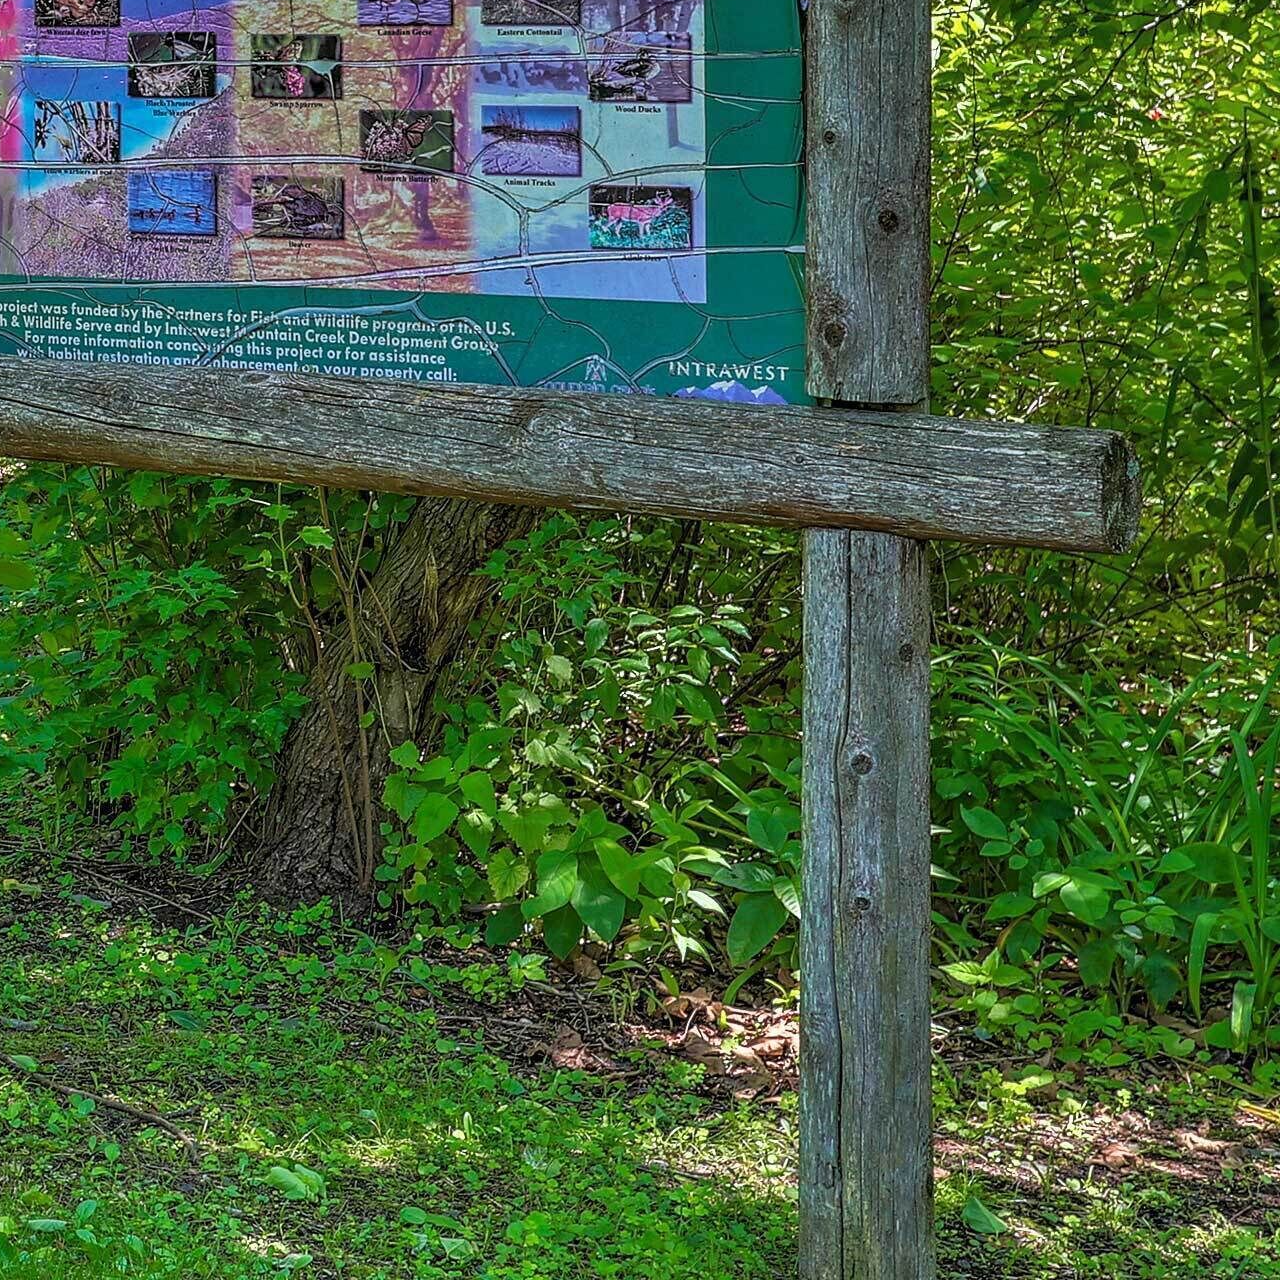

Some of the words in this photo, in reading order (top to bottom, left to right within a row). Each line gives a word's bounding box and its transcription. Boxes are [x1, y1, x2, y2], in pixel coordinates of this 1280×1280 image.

[75, 28, 90, 36] deer
[377, 28, 410, 37] Canadian
[411, 28, 433, 37] Geese
[497, 28, 525, 37] Eastern
[525, 28, 563, 37] Cottontail
[269, 101, 295, 110] Swamp
[295, 101, 324, 110] Sparrow
[614, 105, 636, 113] Wood
[637, 105, 662, 114] Ducks
[375, 174, 407, 184] Monarch
[408, 175, 439, 185] Butterfly
[503, 178, 530, 187] Animal
[531, 178, 556, 187] Tracks
[289, 241, 312, 250] Beaver
[39, 302, 68, 316] was
[70, 301, 118, 318] funded
[120, 303, 139, 322] by
[140, 304, 165, 320] the
[166, 306, 224, 323] Partners
[226, 310, 247, 325] for
[249, 310, 279, 326] Fish
[281, 311, 310, 327] and
[312, 311, 369, 330] Wildlife
[371, 320, 436, 338] program
[457, 320, 481, 335] the
[485, 321, 516, 337] U.S.
[11, 315, 20, 329] &
[22, 315, 73, 331] Wildlife
[75, 318, 113, 333] Serve
[114, 318, 141, 335] and
[143, 319, 162, 338] by
[304, 329, 346, 345] Creek
[348, 331, 450, 352] Development
[451, 336, 500, 356] Group
[24, 330, 46, 344] For
[47, 334, 81, 347] more
[83, 334, 164, 352] information
[166, 340, 245, 358] concerning
[246, 341, 273, 357] this
[275, 344, 324, 364] project
[326, 348, 343, 360] or
[344, 346, 366, 362] for
[368, 349, 447, 365] assistance
[47, 346, 95, 362] habitat
[96, 352, 170, 367] restoration
[323, 365, 357, 376] your
[360, 365, 423, 381] property
[425, 369, 458, 383] call:
[668, 361, 790, 382] INTRAWEST
